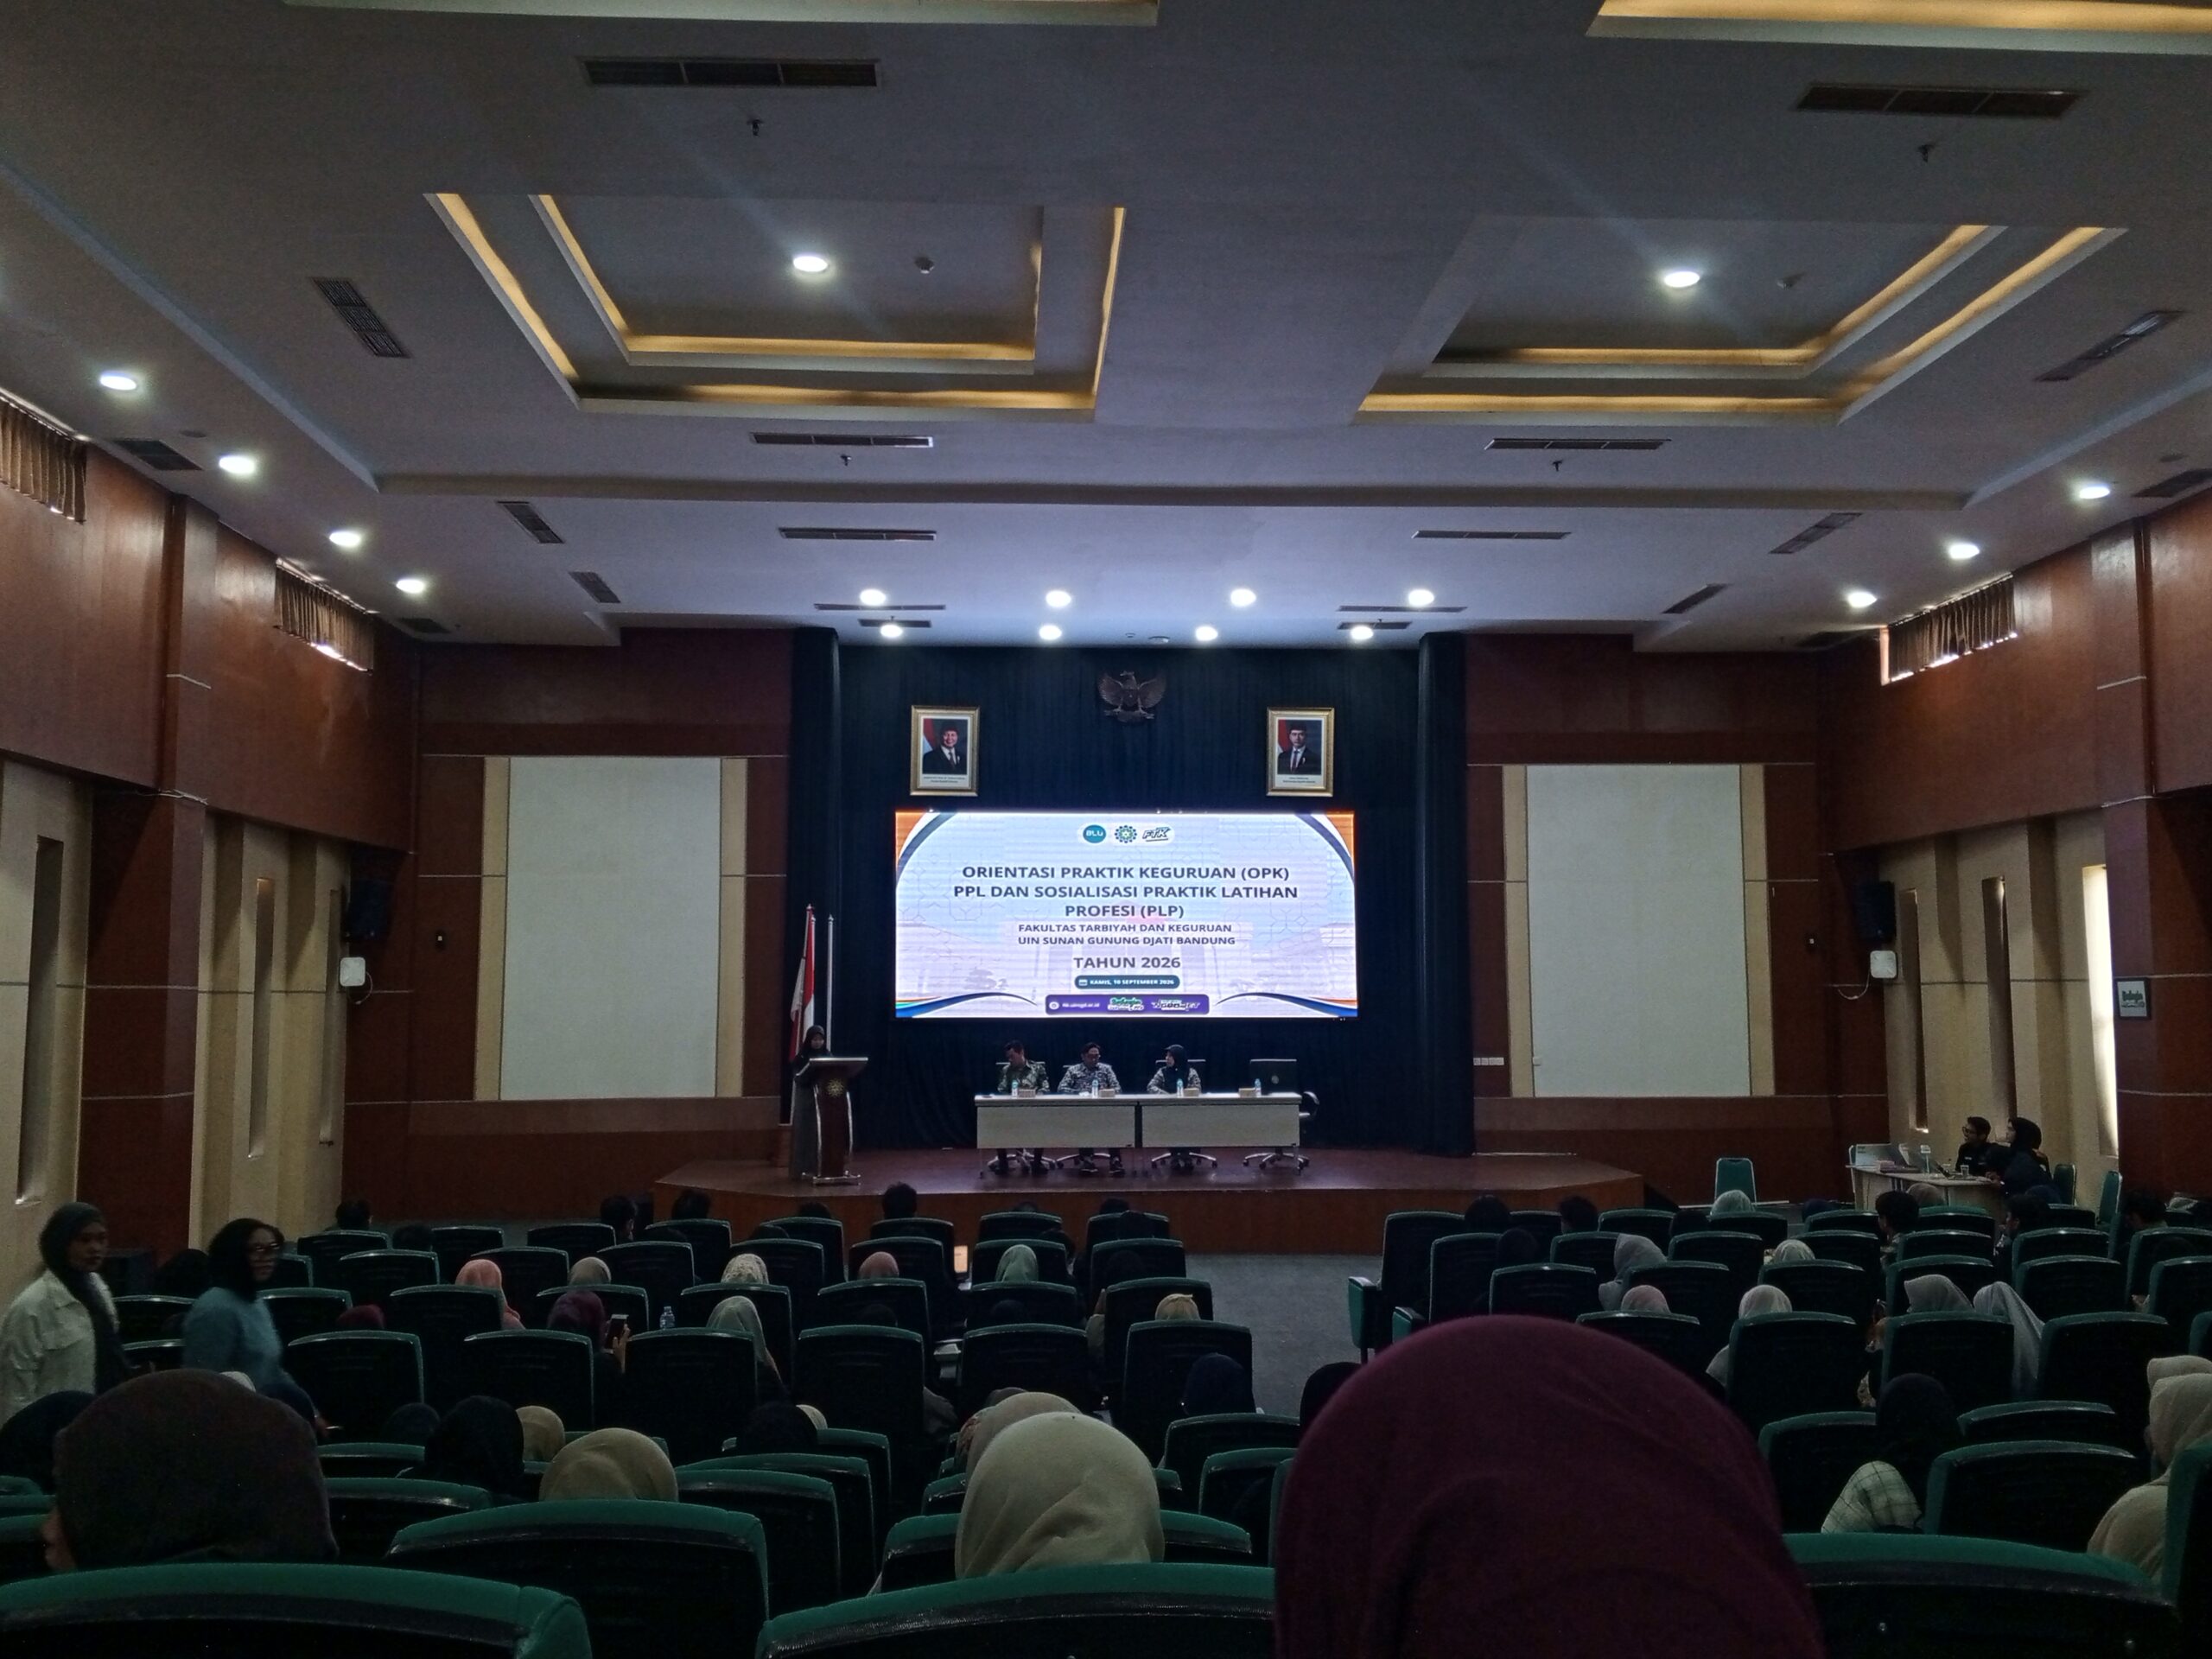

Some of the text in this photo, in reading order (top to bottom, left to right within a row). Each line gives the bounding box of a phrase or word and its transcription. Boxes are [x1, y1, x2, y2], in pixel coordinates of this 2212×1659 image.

[1142, 826, 1171, 840] FTK
[962, 867, 1289, 881] ORIENTASI PRAKTIK KEGURUAN (OPK)
[954, 886, 1297, 898] PPL DAN SOSIALISASI PRAKTIK LATIHAN
[1065, 905, 1185, 918] PROFESI (PLP)
[1018, 924, 1232, 932] FAKULTAS TARBIYAH DAN KEGURUAN
[1143, 937, 1173, 946] DJATI
[1073, 957, 1181, 969] TAHUN 2026
